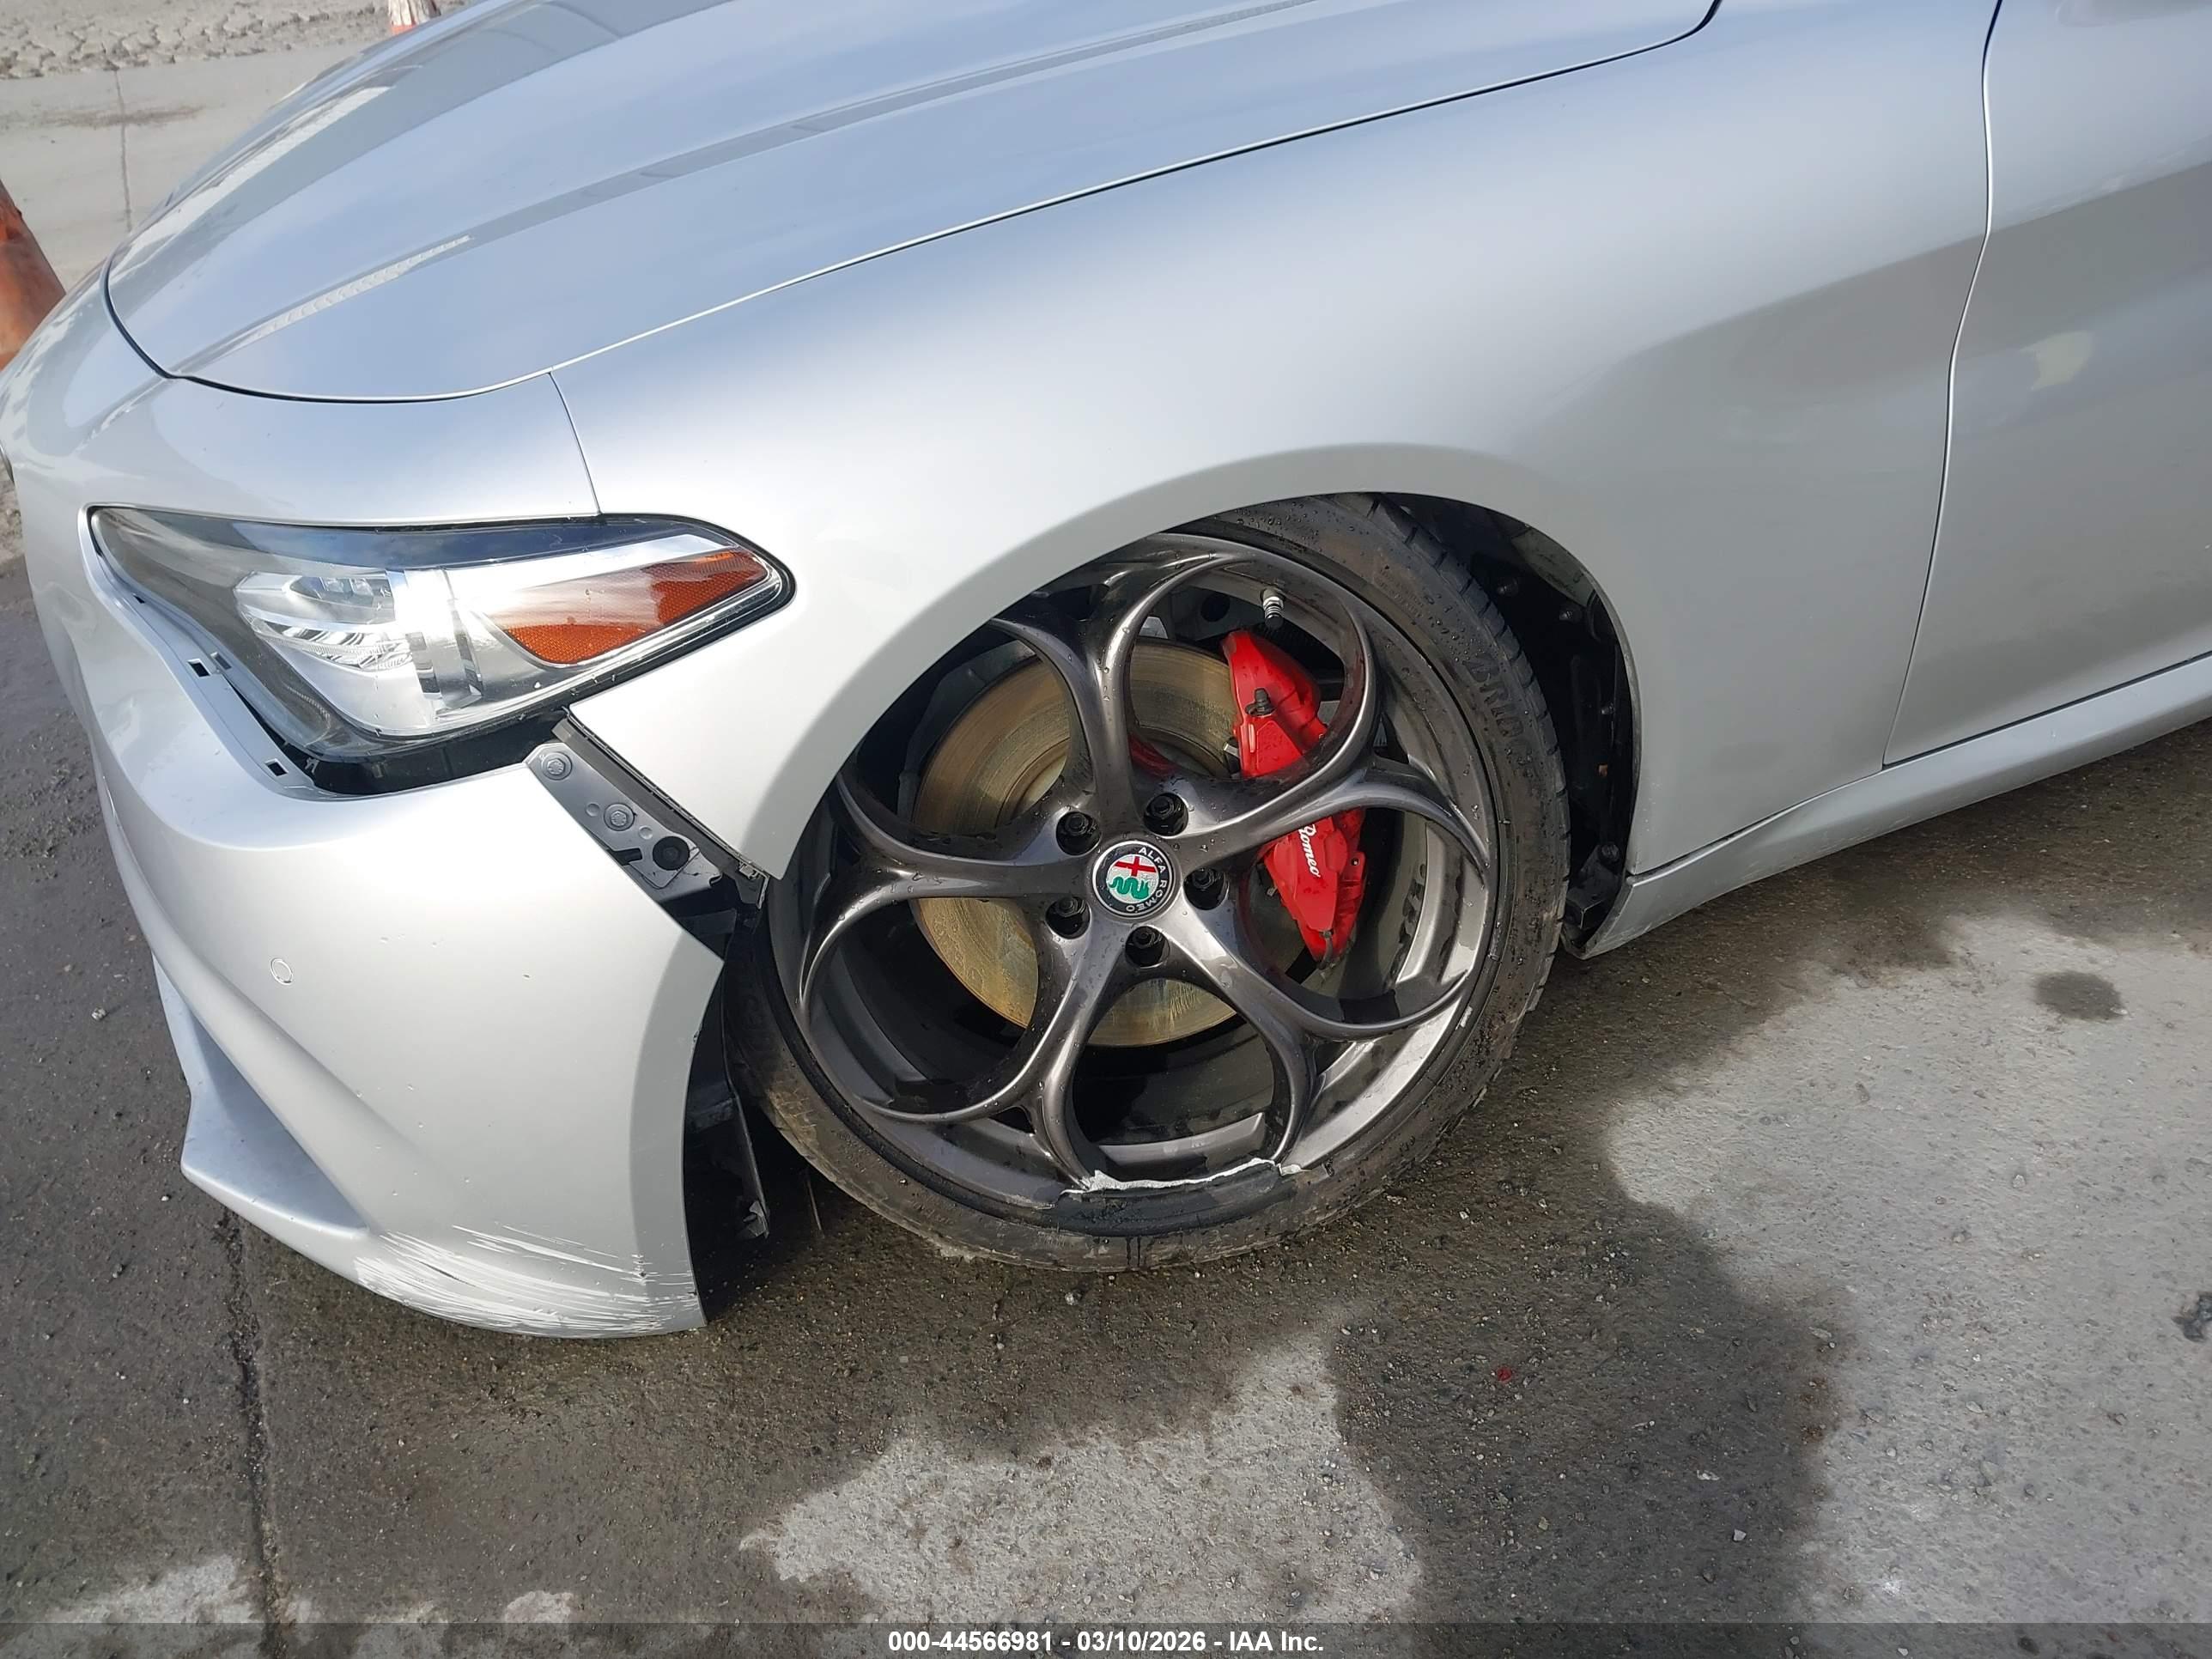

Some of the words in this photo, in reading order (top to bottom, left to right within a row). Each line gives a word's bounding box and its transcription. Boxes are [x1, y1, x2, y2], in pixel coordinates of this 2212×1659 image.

[1139, 847, 1166, 872] ALFA
[1297, 824, 1321, 878] Romeo
[1126, 879, 1167, 912] ROMEO
